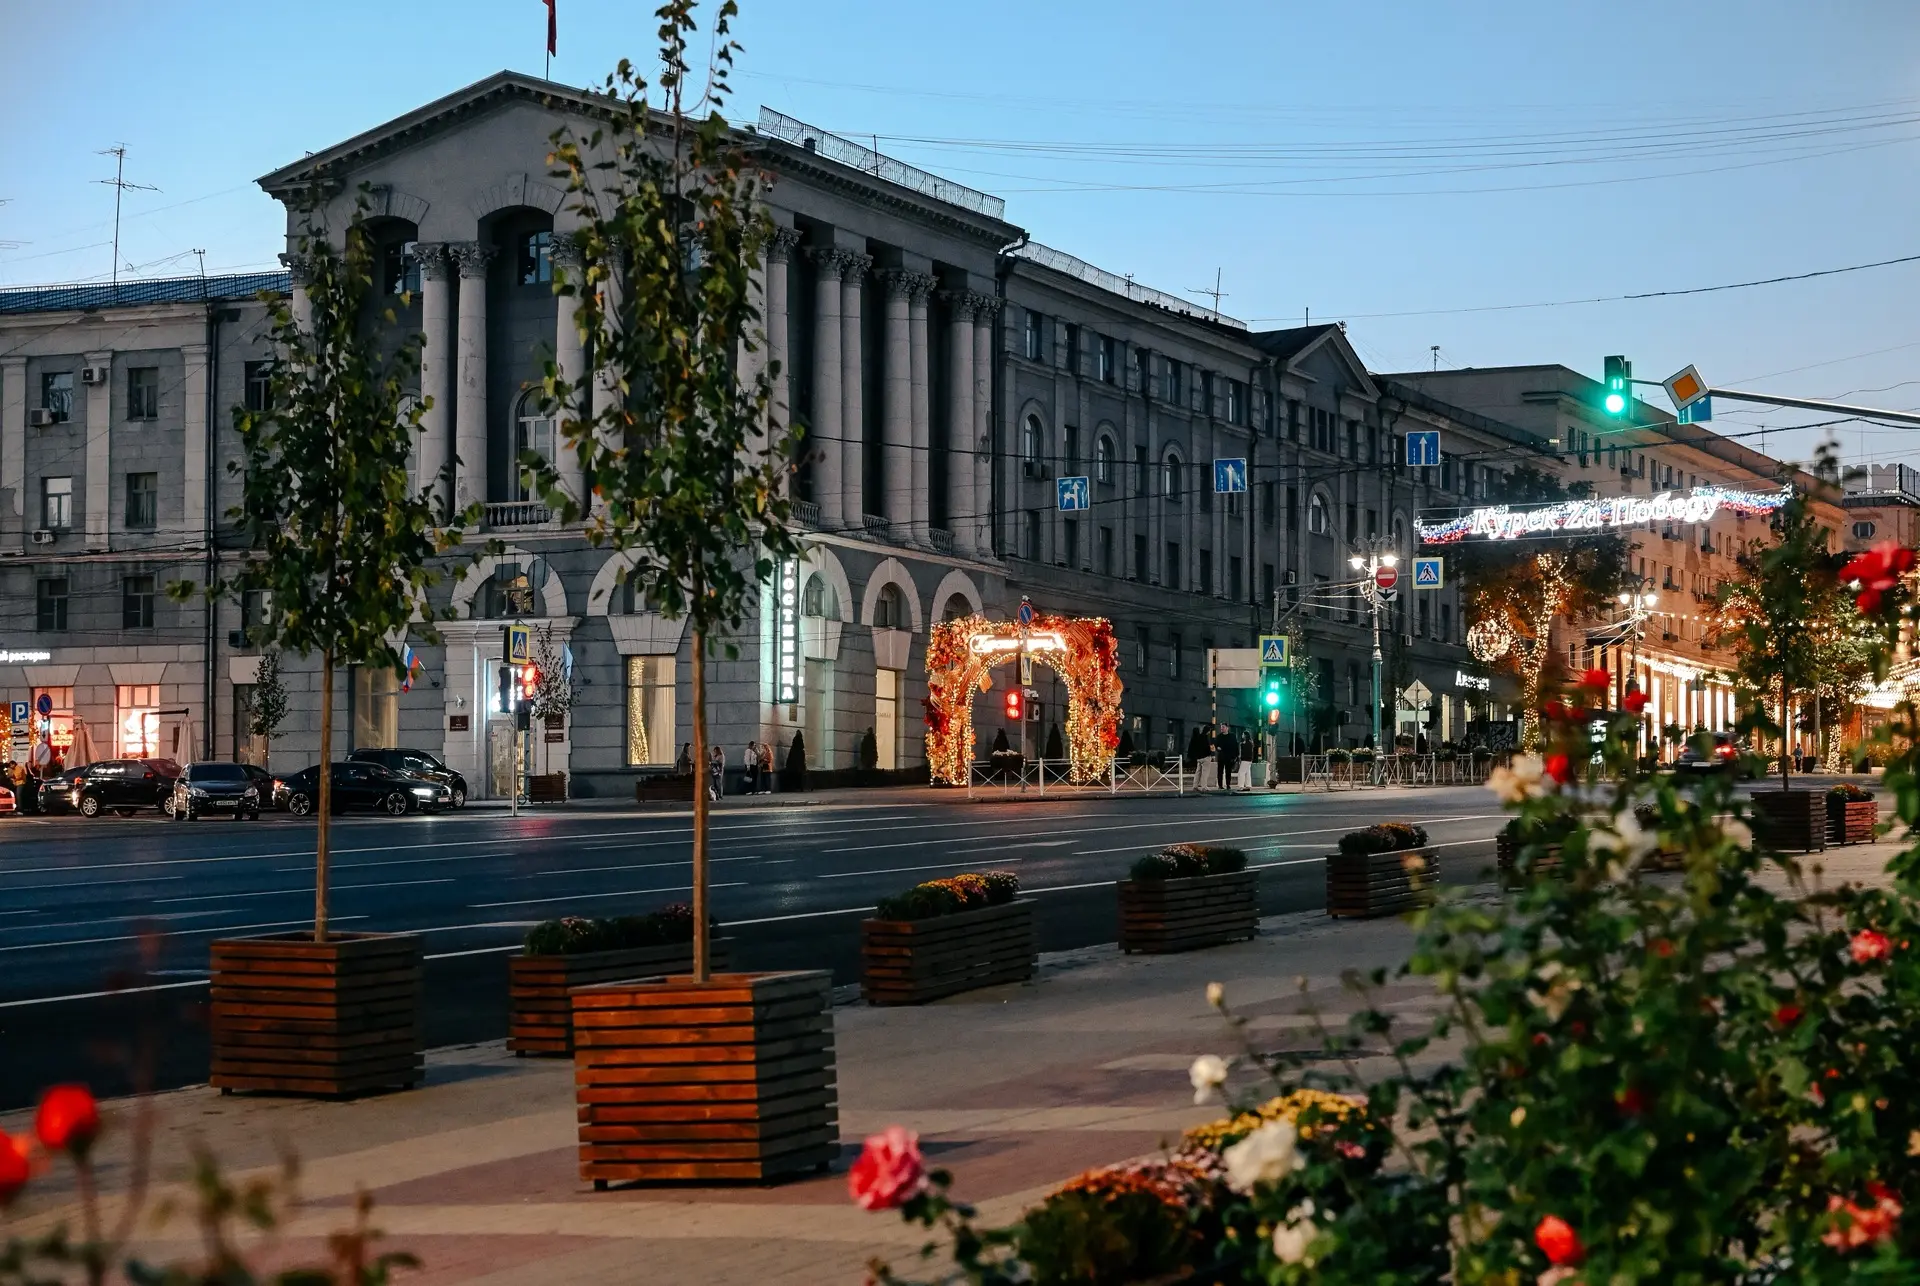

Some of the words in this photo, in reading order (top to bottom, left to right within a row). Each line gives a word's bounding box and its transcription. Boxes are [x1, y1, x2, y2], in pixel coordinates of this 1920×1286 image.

[1471, 508, 1560, 539] Курск
[1563, 503, 1603, 528] Za
[1610, 491, 1722, 527] Победу
